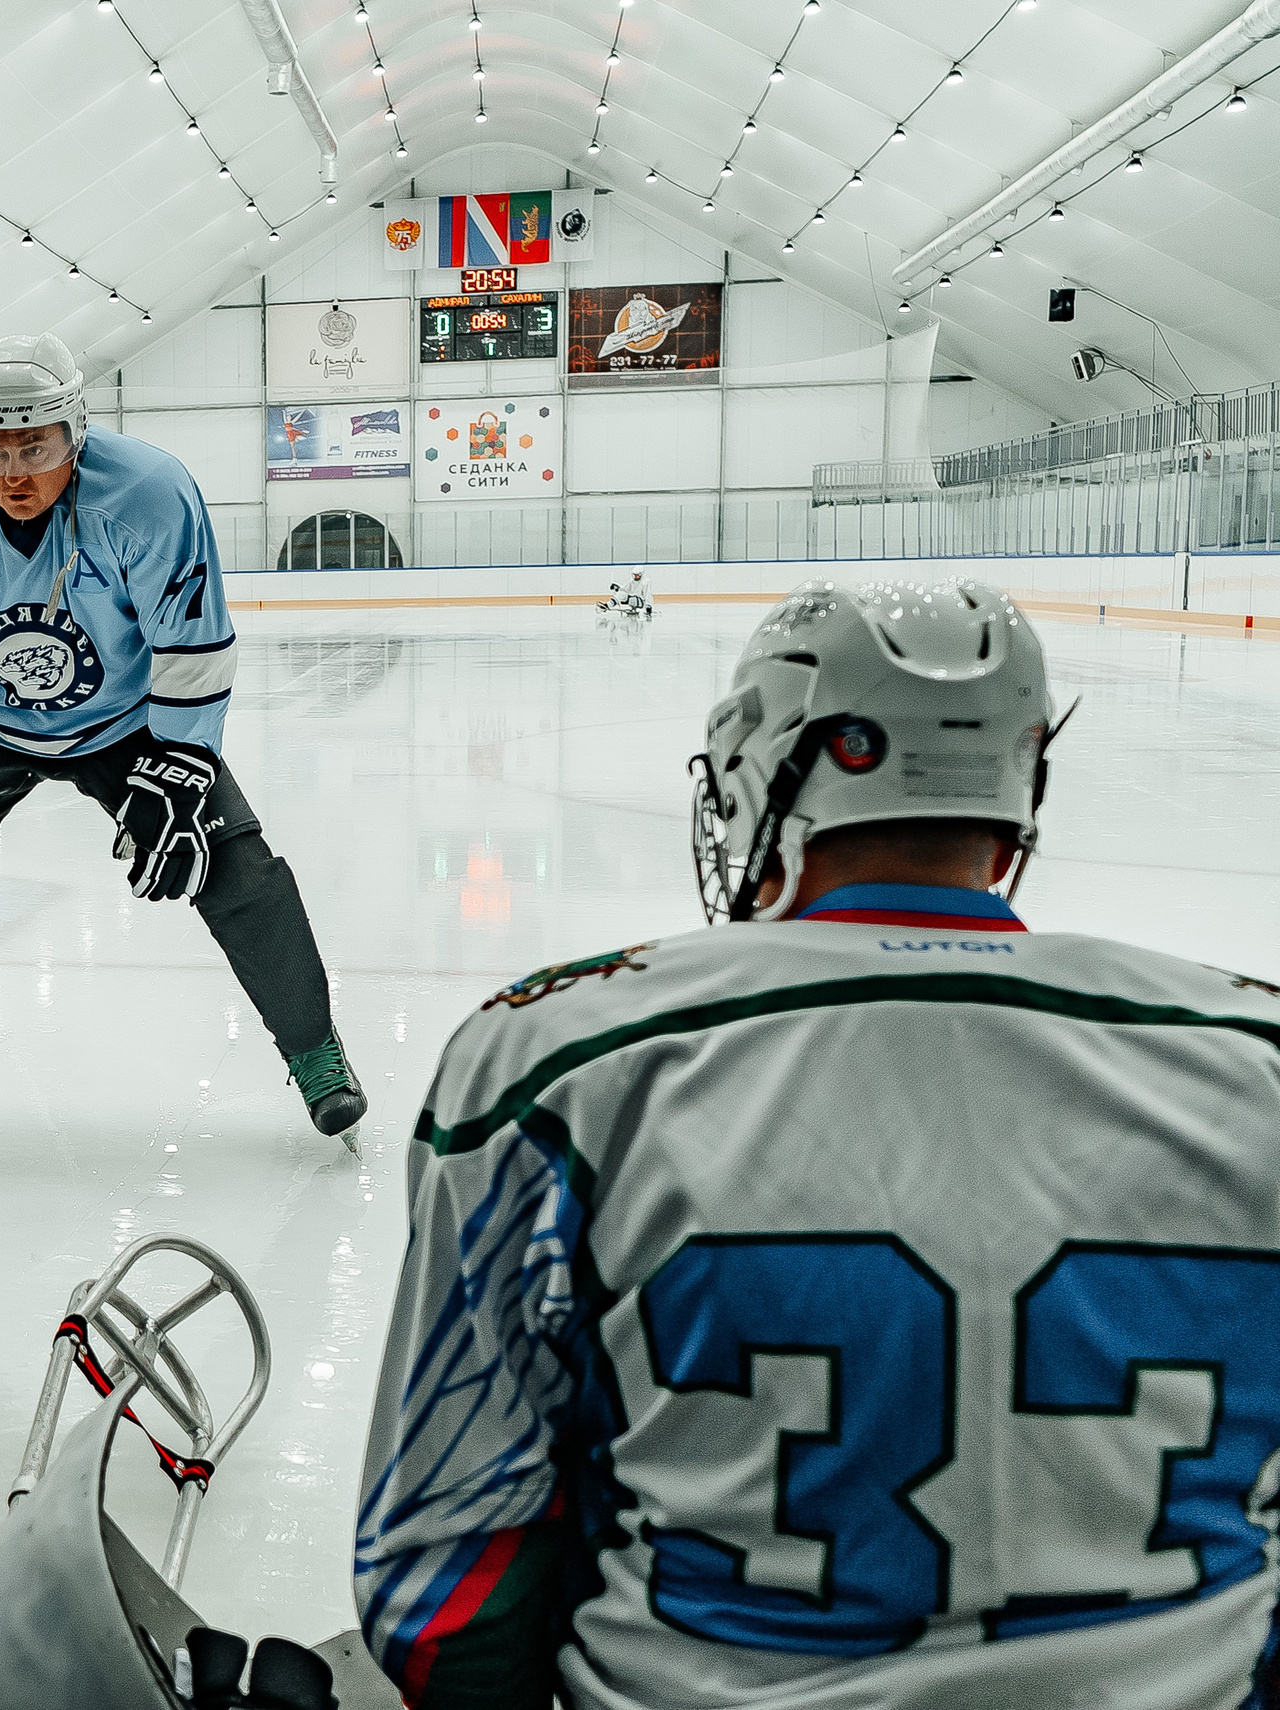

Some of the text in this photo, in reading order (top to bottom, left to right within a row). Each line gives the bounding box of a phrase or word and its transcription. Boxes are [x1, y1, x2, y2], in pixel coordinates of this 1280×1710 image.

[394, 230, 412, 244] 75
[464, 269, 516, 291] 20:54
[428, 296, 470, 308] АДМИРАЛ
[500, 293, 543, 304] САХАЛИН
[436, 313, 450, 335] 0
[539, 308, 553, 330] 3
[609, 354, 678, 367] 231-77-77
[353, 449, 399, 459] FITNESS
[448, 461, 529, 475] СЕДАНКА
[467, 476, 509, 488] СИТИ
[71, 547, 111, 589] A
